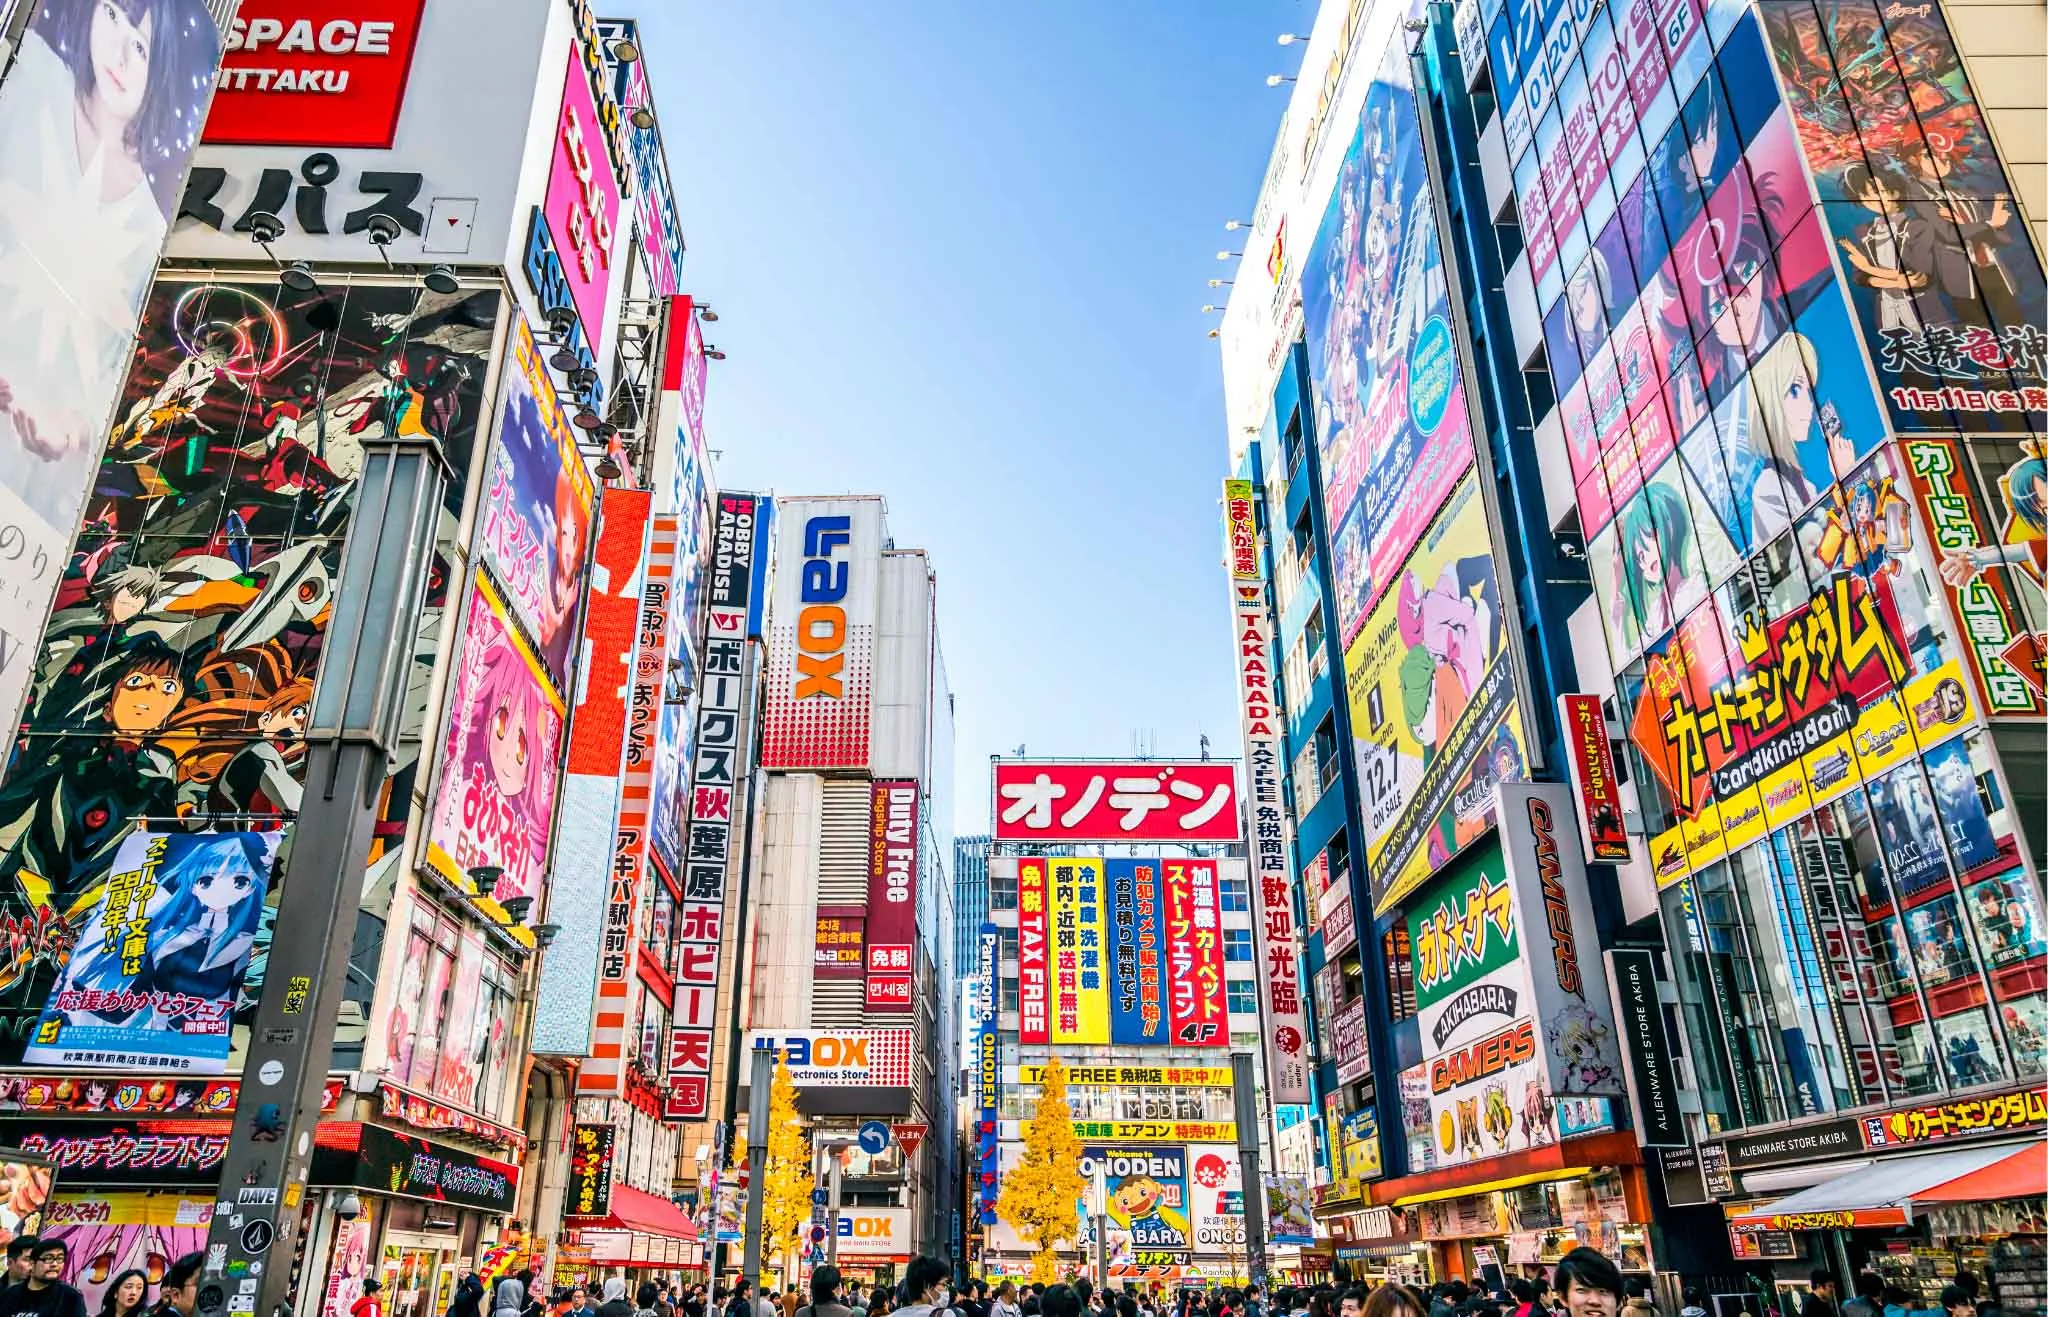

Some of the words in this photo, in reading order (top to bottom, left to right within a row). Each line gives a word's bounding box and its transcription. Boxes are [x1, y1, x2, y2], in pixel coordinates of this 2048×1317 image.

[1668, 3, 1689, 47] 6F
[217, 68, 350, 93] ITTAKU
[712, 499, 737, 603] PARADISE
[734, 499, 753, 569] HOBBY
[1229, 499, 1257, 574] まんが喫茶
[640, 583, 668, 648] 買取り
[795, 515, 851, 699] Laox
[1240, 614, 1273, 736] TAKARADA
[1667, 576, 1908, 808] カードキングダム
[1366, 738, 1399, 810] 12.7
[873, 788, 888, 839] Flagship
[885, 788, 916, 844] Duty
[1000, 767, 1231, 831] オノデン
[1373, 808, 1384, 831] ON
[1385, 791, 1402, 822] SALE
[873, 841, 888, 876] Store
[886, 848, 914, 904] Free
[121, 836, 169, 977] スニーカー文庫は
[601, 830, 638, 979] アキバ駅前店
[1022, 864, 1043, 912] 免税
[1527, 796, 1586, 1003] GAMERS
[817, 920, 840, 931] 本店
[1022, 916, 1044, 962] TAX
[871, 950, 909, 967] 免税
[981, 934, 997, 1021] Panasonic
[54, 989, 236, 1019] 応援ありがとうフェア
[869, 983, 909, 997] 면세점
[1023, 968, 1045, 1033] FREE
[1627, 963, 1645, 1003] AKIBA
[184, 1020, 227, 1035] 開催中!!
[1180, 1024, 1217, 1041] 4F
[1440, 987, 1508, 1035] AKIHABARA
[1637, 1006, 1653, 1049] STORE
[842, 1069, 869, 1079] Store
[982, 1032, 995, 1109] ONODEN
[1069, 1068, 1117, 1083] FREE
[1120, 1069, 1163, 1083] 免税店
[1431, 1021, 1536, 1095] GAMERS
[1645, 1051, 1668, 1131] ALIENWARE
[899, 1131, 921, 1140] 止まれ
[1073, 1123, 1113, 1137] 冷蔵庫
[1118, 1124, 1171, 1137] エアコン
[1908, 1092, 2048, 1139] カードキングダム
[1106, 1150, 1142, 1159] Welcome
[1142, 1151, 1154, 1159] to
[1665, 1148, 1693, 1159] ALIENWARE
[1740, 1141, 1787, 1158] ALIENWARE
[1788, 1136, 1818, 1152] STORE
[1819, 1130, 1849, 1146] AKIBA
[238, 1188, 278, 1204] DAVE
